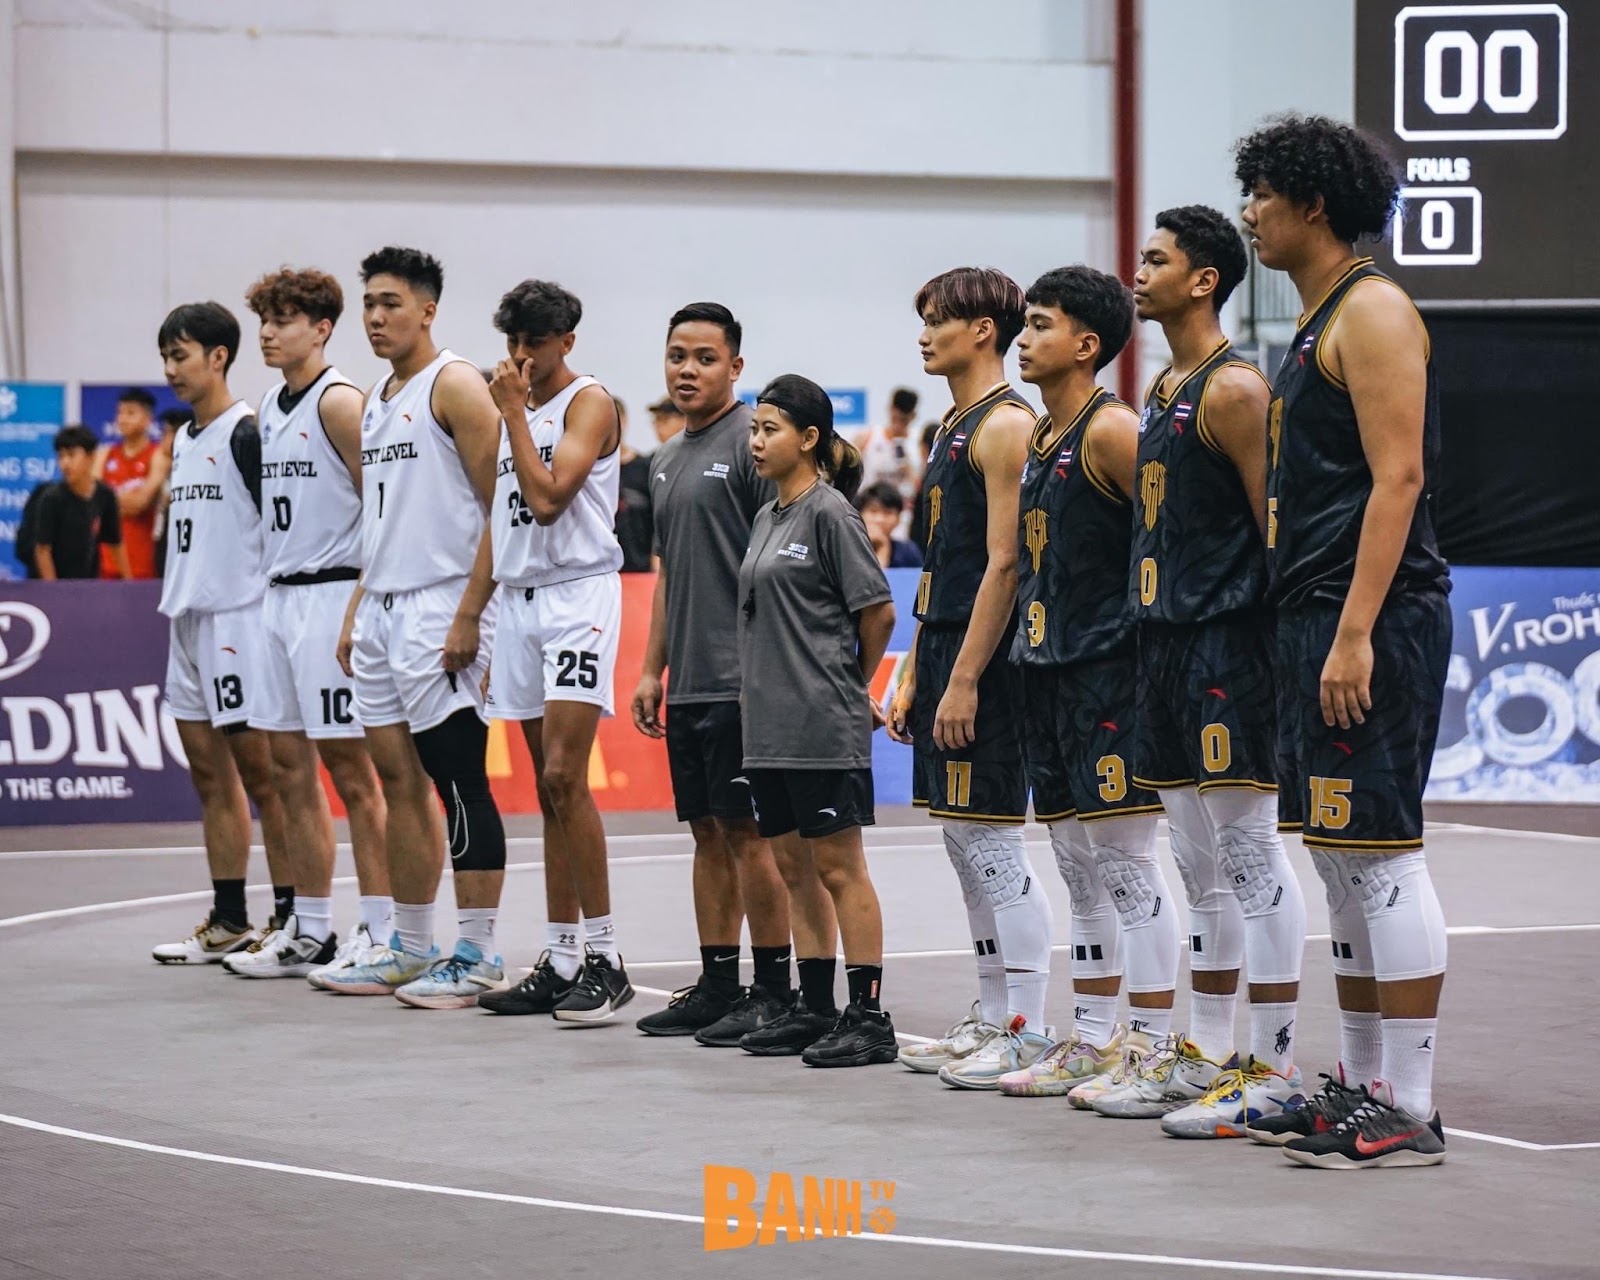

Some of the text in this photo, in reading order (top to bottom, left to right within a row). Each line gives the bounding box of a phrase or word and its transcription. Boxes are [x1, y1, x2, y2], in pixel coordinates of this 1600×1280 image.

[1424, 29, 1539, 114] 00
[1406, 157, 1471, 181] FOULS
[1421, 200, 1454, 249] 0
[261, 461, 318, 479] EXT LEVEL
[361, 442, 418, 466] EXT LEVEL
[185, 484, 223, 500] LEVEL
[378, 481, 384, 519] 1
[175, 518, 193, 554] 13
[1140, 557, 1157, 606] 0
[1027, 601, 1046, 647] 3
[555, 649, 599, 690] 25
[213, 674, 244, 712] 13
[320, 687, 353, 724] 10
[1200, 722, 1231, 773] 0
[5, 777, 54, 801] THE
[946, 760, 972, 807] 11
[1096, 754, 1127, 802] 3
[1308, 775, 1352, 829] 15
